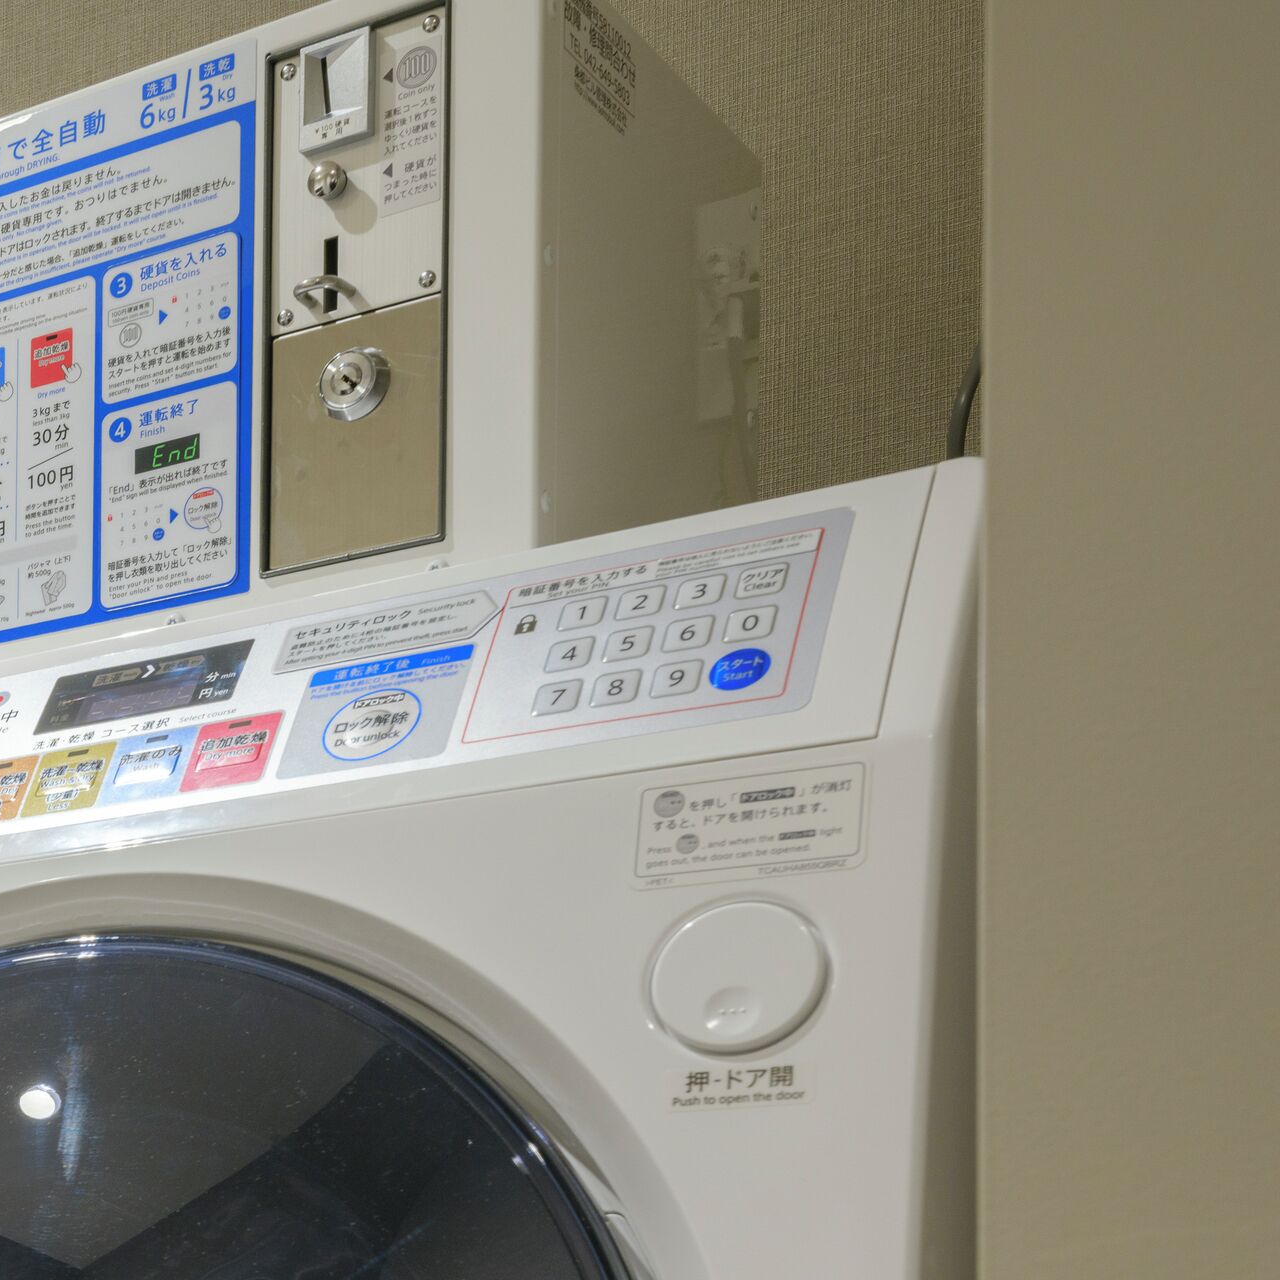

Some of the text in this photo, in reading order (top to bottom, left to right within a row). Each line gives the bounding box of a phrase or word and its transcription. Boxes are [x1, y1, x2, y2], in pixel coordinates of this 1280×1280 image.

[202, 55, 230, 79] 洗乾
[384, 96, 438, 120] 運転コースを
[404, 154, 438, 173] 硬貨が
[140, 241, 227, 281] 硬貨を入れる
[140, 266, 200, 293] Deposit Coins
[107, 325, 230, 368] 硬貨を入れて暗証番号を入力後
[107, 337, 230, 379] スタートを押すと運転を始めます
[138, 398, 198, 428] 運転終了
[140, 424, 165, 439] Finish
[152, 435, 198, 468] End
[107, 548, 227, 583] を押し衣類を取り出してください
[518, 565, 648, 598] 暗証番号を入力する
[743, 568, 783, 584] クリア
[743, 579, 778, 593] Clear
[694, 584, 709, 599] 3
[632, 596, 648, 611] 2
[578, 607, 587, 621] 1
[743, 616, 759, 631] 0
[294, 609, 412, 641] セキュリティロック
[681, 625, 695, 641] 6
[621, 636, 635, 651] 5
[562, 646, 577, 662] 4
[718, 656, 764, 672] スタート
[332, 659, 411, 682] 運転終了後
[671, 670, 685, 686] 9
[553, 690, 567, 705] 7
[608, 679, 624, 696] 8
[333, 711, 409, 733] ロック解除
[201, 731, 269, 752] 追加乾燥
[120, 745, 182, 767] 洗濯のみ
